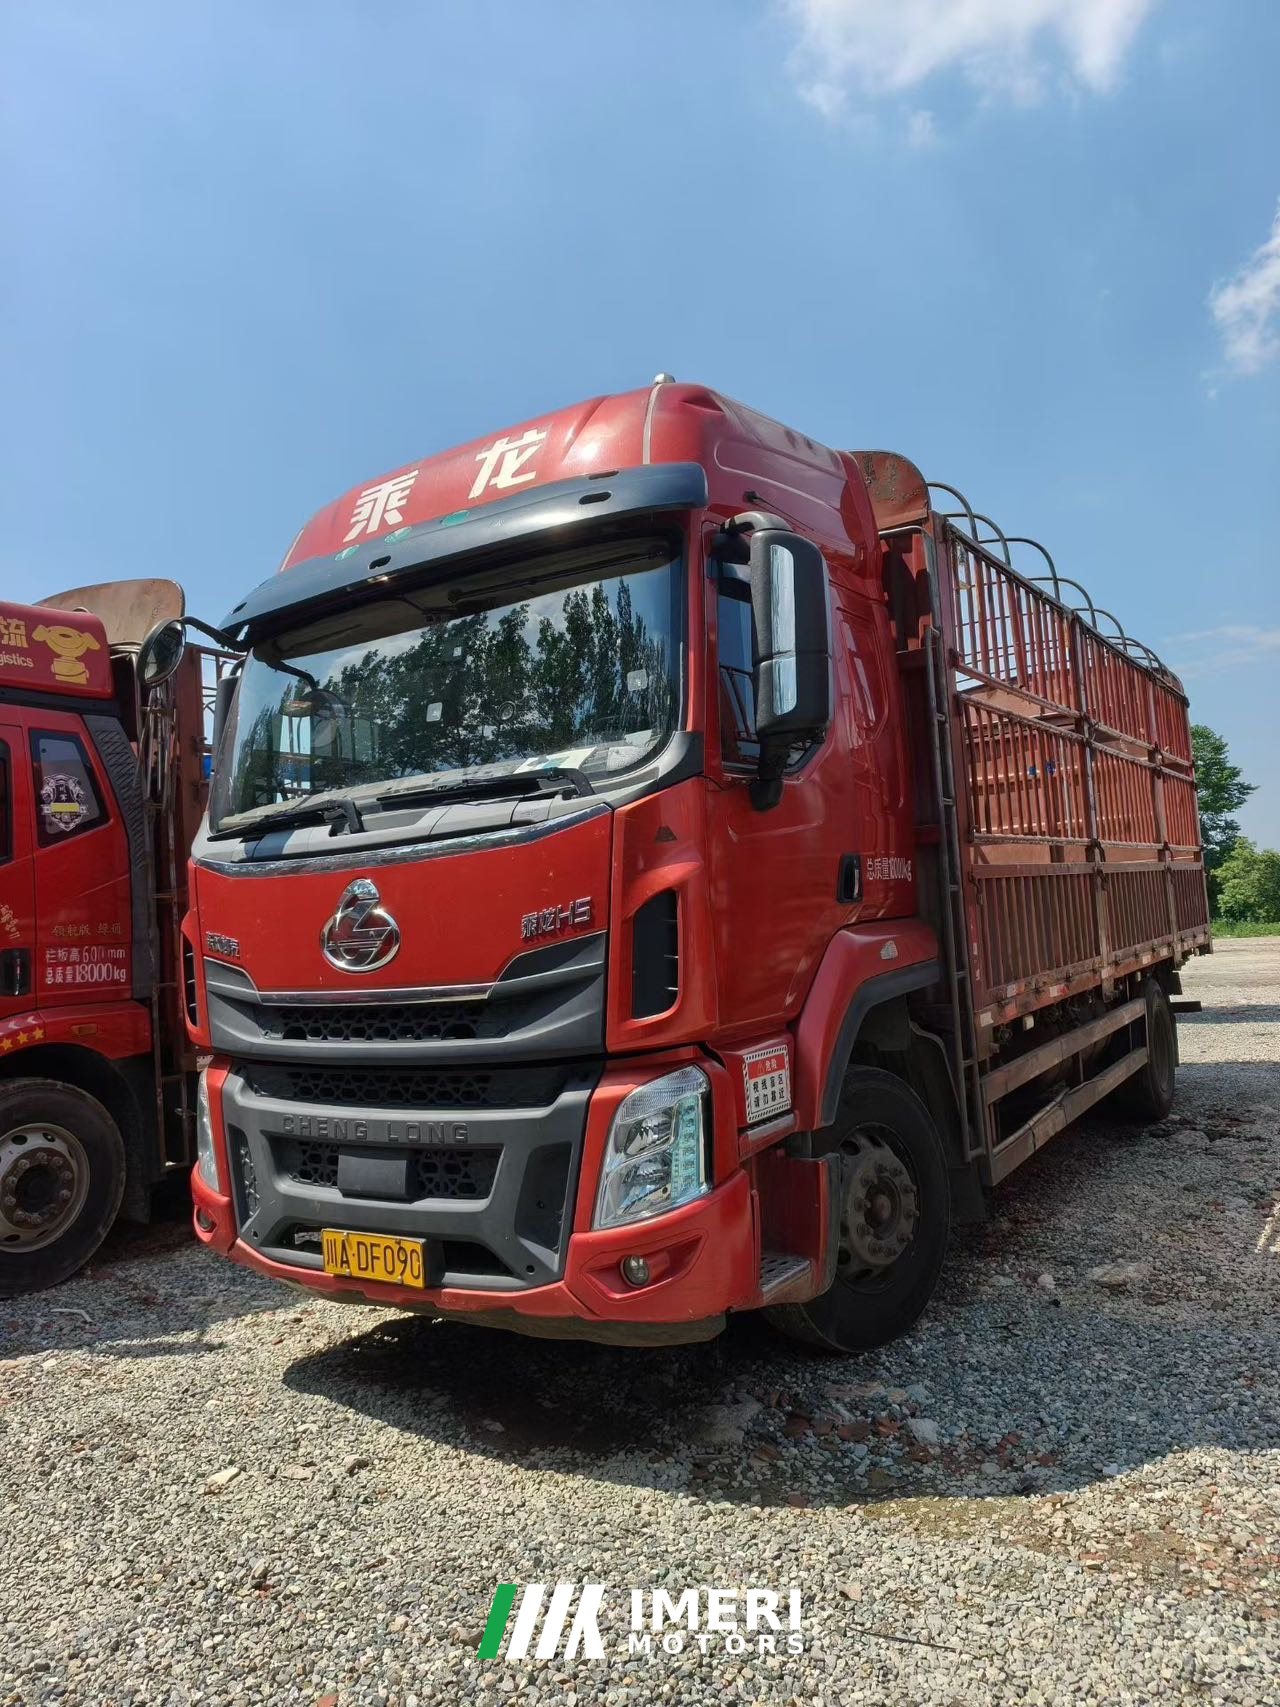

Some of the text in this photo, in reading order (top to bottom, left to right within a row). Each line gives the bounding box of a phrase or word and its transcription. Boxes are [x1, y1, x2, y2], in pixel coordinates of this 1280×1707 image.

[343, 429, 547, 543] 乘龙
[282, 1114, 468, 1144] CHENG LONG
